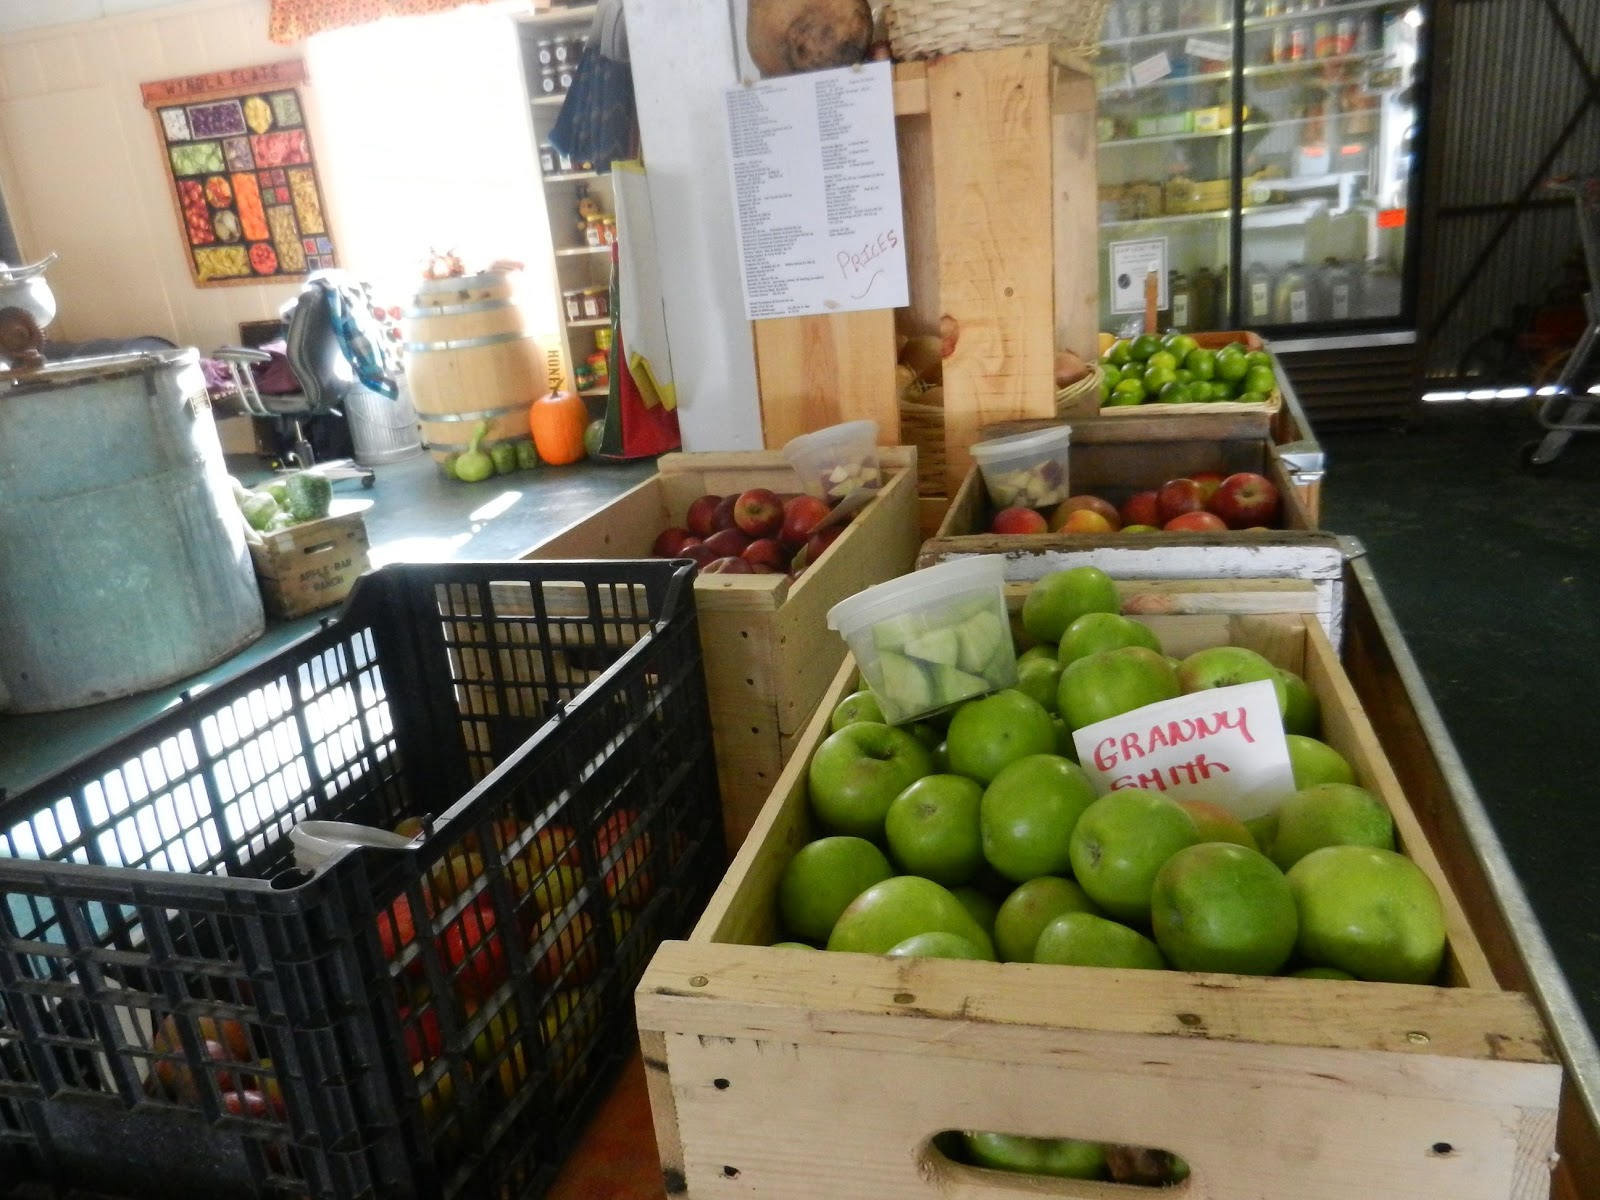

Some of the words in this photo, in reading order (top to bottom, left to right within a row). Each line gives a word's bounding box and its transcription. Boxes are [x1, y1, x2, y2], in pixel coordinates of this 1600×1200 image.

[231, 66, 280, 85] FLATS
[837, 229, 898, 279] PRICES
[314, 575, 344, 590] RANCH
[1093, 706, 1256, 772] GRANNY
